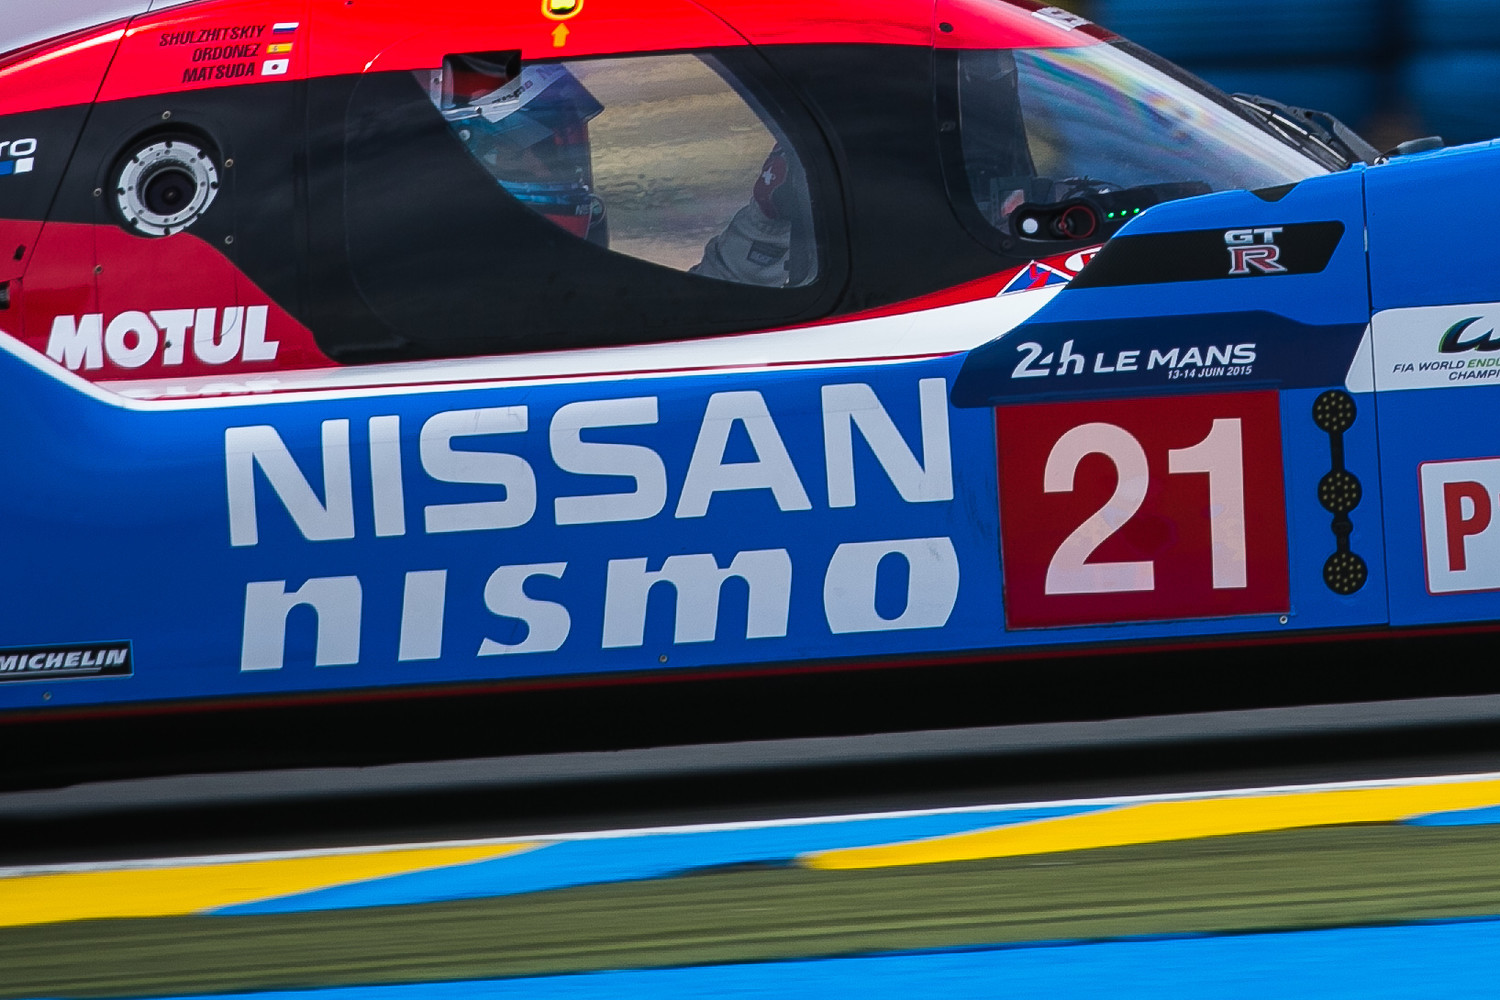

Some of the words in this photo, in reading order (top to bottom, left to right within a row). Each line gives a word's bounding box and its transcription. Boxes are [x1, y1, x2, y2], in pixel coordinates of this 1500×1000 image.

[159, 25, 266, 47] SHULZHITSKIY
[192, 43, 261, 62] ORDONEZ
[182, 62, 256, 83] MATSUDA
[1224, 227, 1283, 244] GT
[1227, 244, 1288, 274] R
[46, 305, 280, 371] MOTUL
[1093, 350, 1141, 374] LE
[1147, 343, 1257, 370] MANS
[1392, 363, 1415, 374] FIA
[1418, 360, 1465, 372] WORLD
[1167, 367, 1196, 380] 13-14
[1198, 366, 1225, 378] JUIN
[1226, 365, 1253, 376] 2015
[225, 377, 954, 547] NISSAN
[1043, 417, 1248, 596] 21
[240, 537, 960, 672] nismo
[0, 648, 128, 671] MICHELIN
